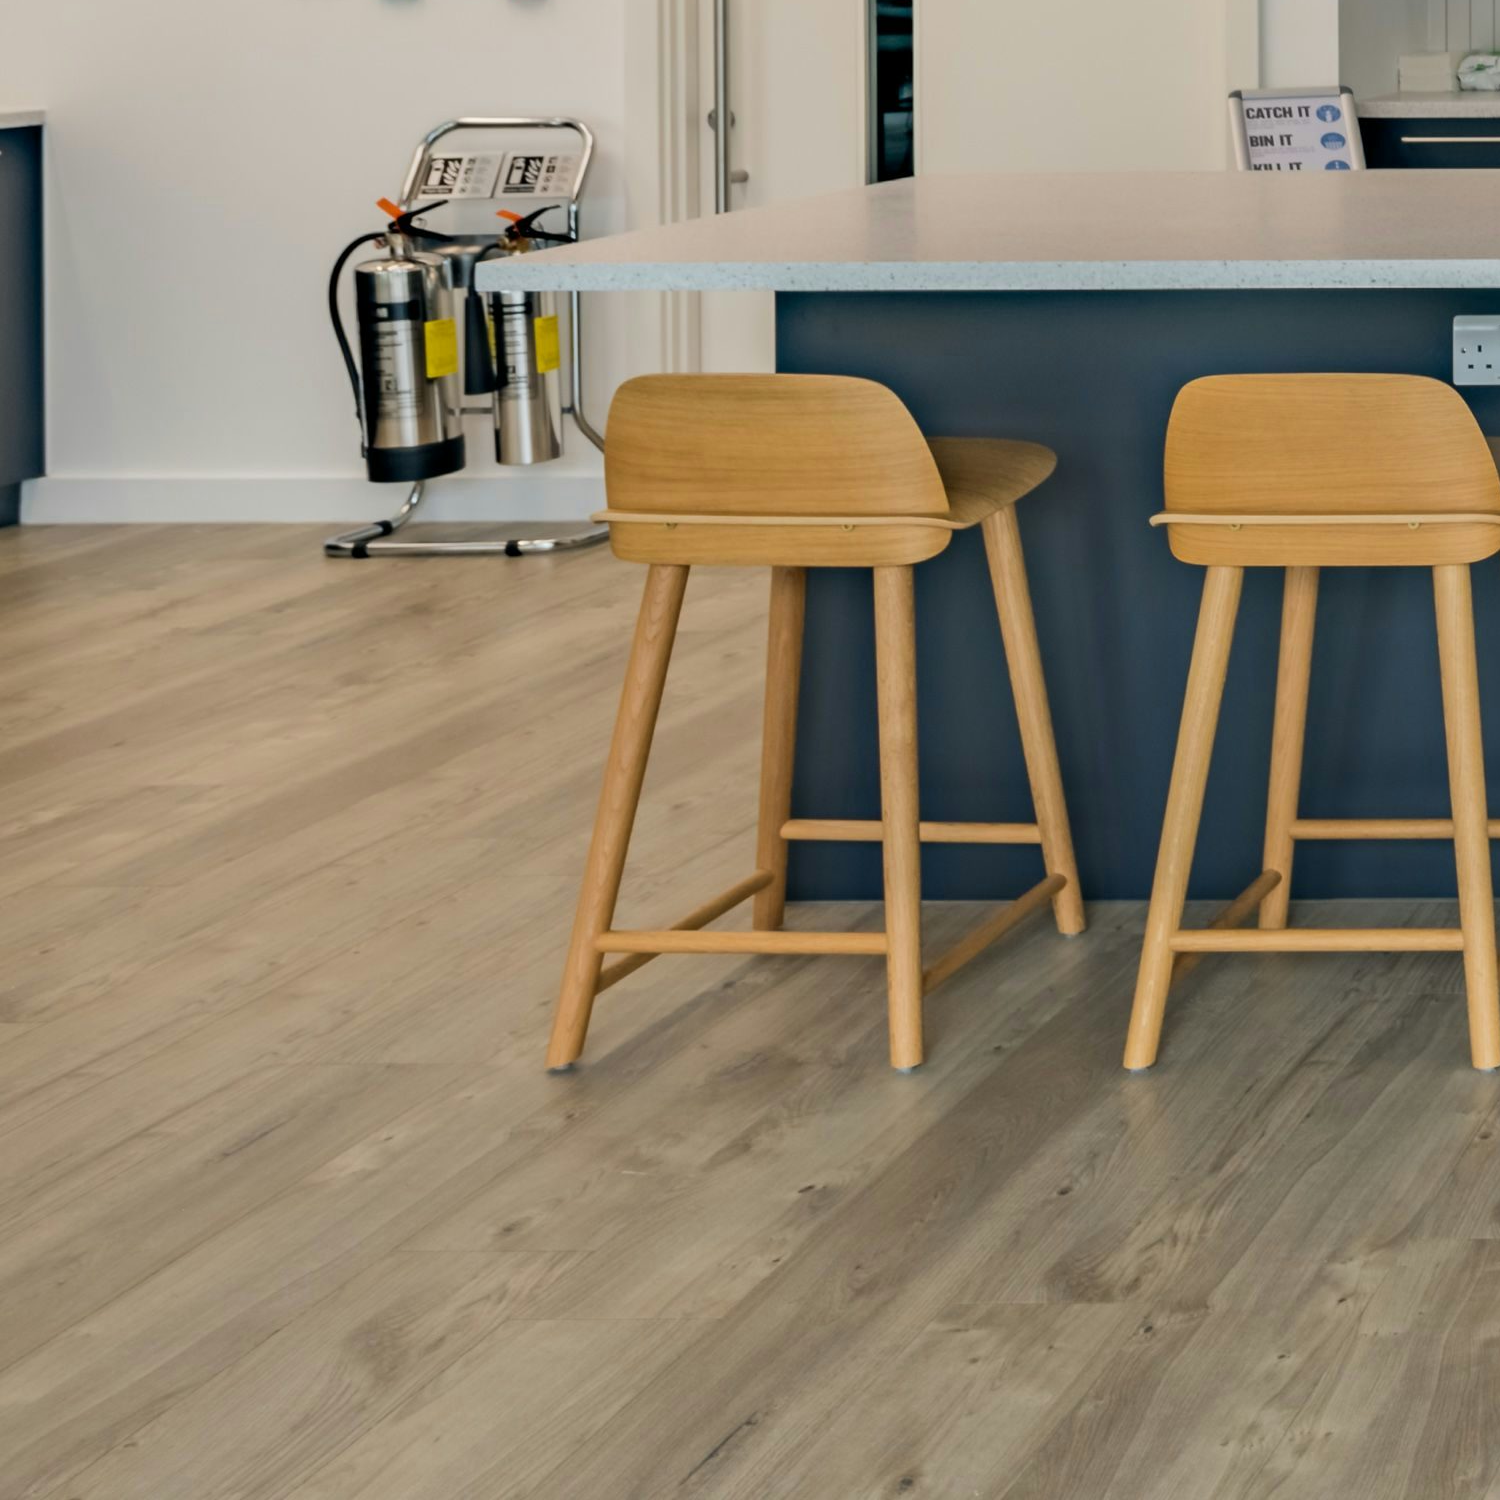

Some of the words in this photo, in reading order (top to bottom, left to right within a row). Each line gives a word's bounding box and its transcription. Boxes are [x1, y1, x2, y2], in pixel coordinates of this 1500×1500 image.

[1245, 106, 1293, 120] CATCH
[1297, 105, 1311, 118] IT
[1249, 135, 1275, 148] BIN
[1279, 134, 1293, 147] IT
